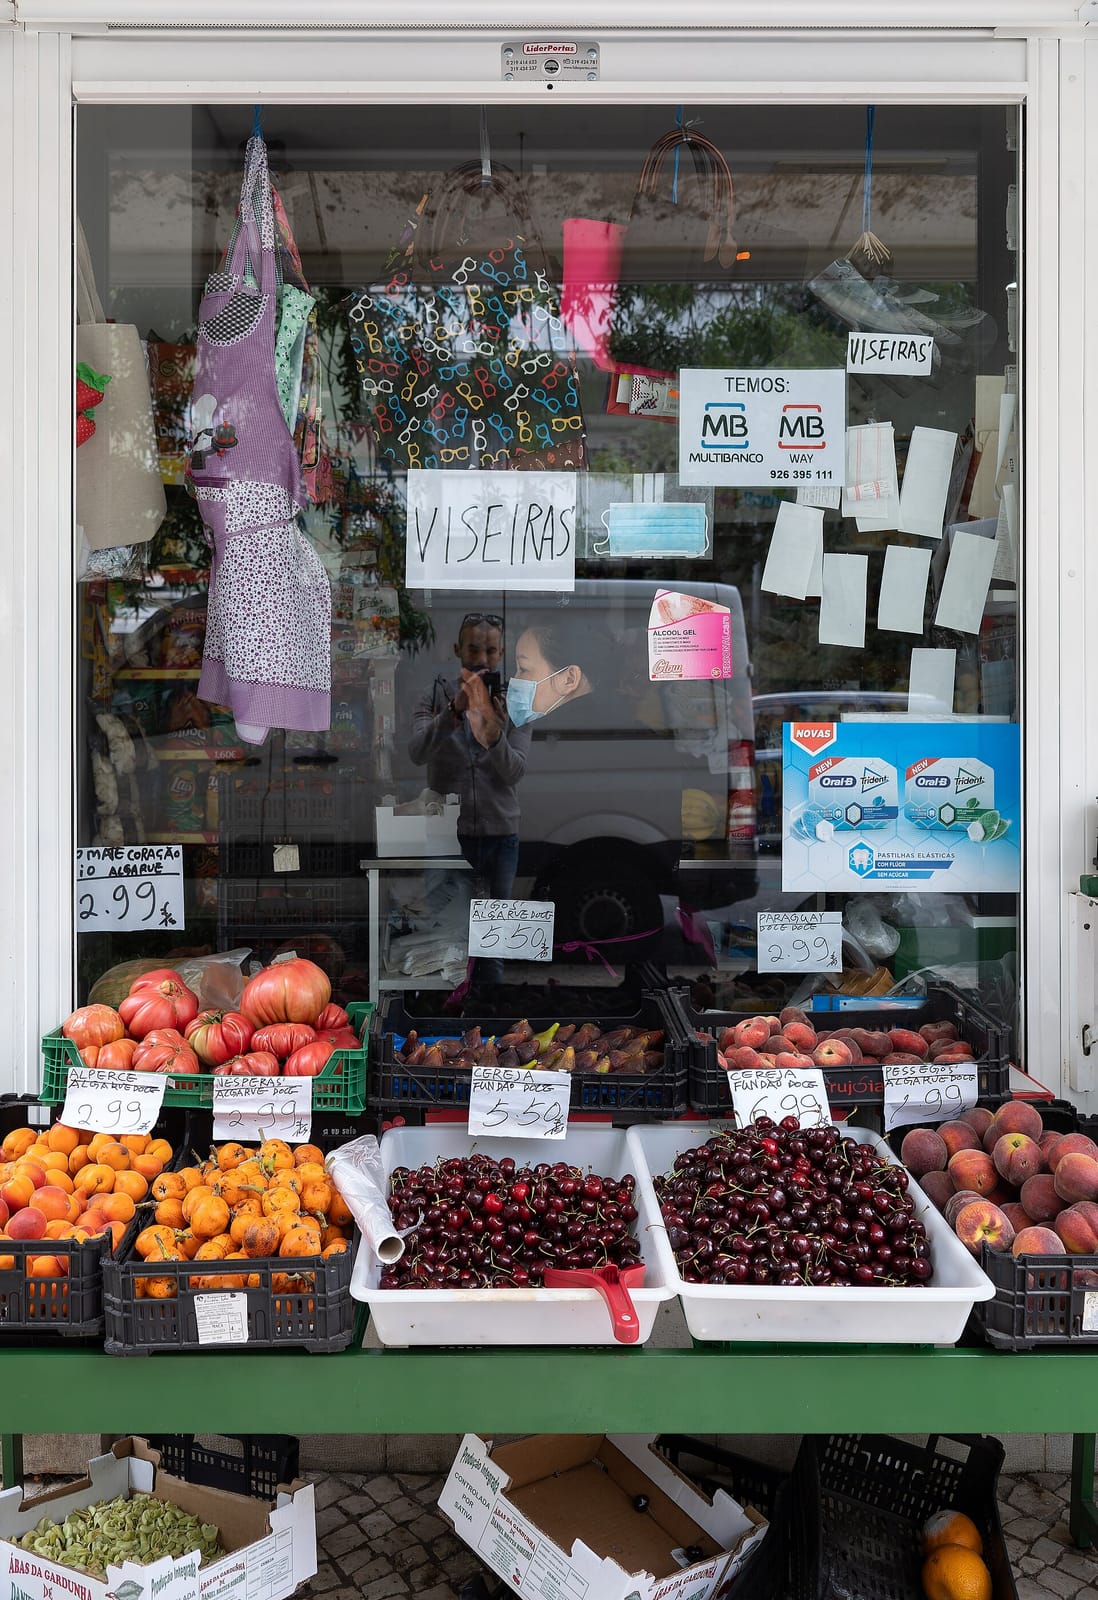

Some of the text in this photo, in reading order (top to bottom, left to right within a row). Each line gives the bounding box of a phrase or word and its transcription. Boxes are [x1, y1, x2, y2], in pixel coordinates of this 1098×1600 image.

[526, 44, 575, 53] LiderPortas
[724, 377, 790, 393] TEMOS:
[702, 414, 748, 438] MB
[779, 415, 824, 438] MB
[689, 453, 764, 463] MULTIBANCO
[789, 454, 813, 463] WAY
[770, 470, 833, 479] 926 395 111
[796, 729, 831, 738] NOVAS
[815, 758, 833, 775] NEW
[912, 759, 928, 775] NEW
[822, 775, 888, 786] Oral-B Trident
[917, 775, 983, 786] Oral-B Trident
[917, 851, 955, 859] ELÁSTICAS
[472, 909, 528, 921] ALGARVE
[760, 912, 825, 924] PARAGUAY
[69, 1068, 137, 1082] ALPERCE
[473, 1067, 534, 1083] CEREJA
[730, 1069, 796, 1081] CEREJA
[454, 1472, 490, 1510] CONTROLADA
[461, 1494, 474, 1508] POR
[454, 1501, 473, 1522] SATIVA
[31, 1564, 43, 1578] DA
[44, 1569, 93, 1600] GARDUNHA
[43, 1583, 53, 1600] DE
